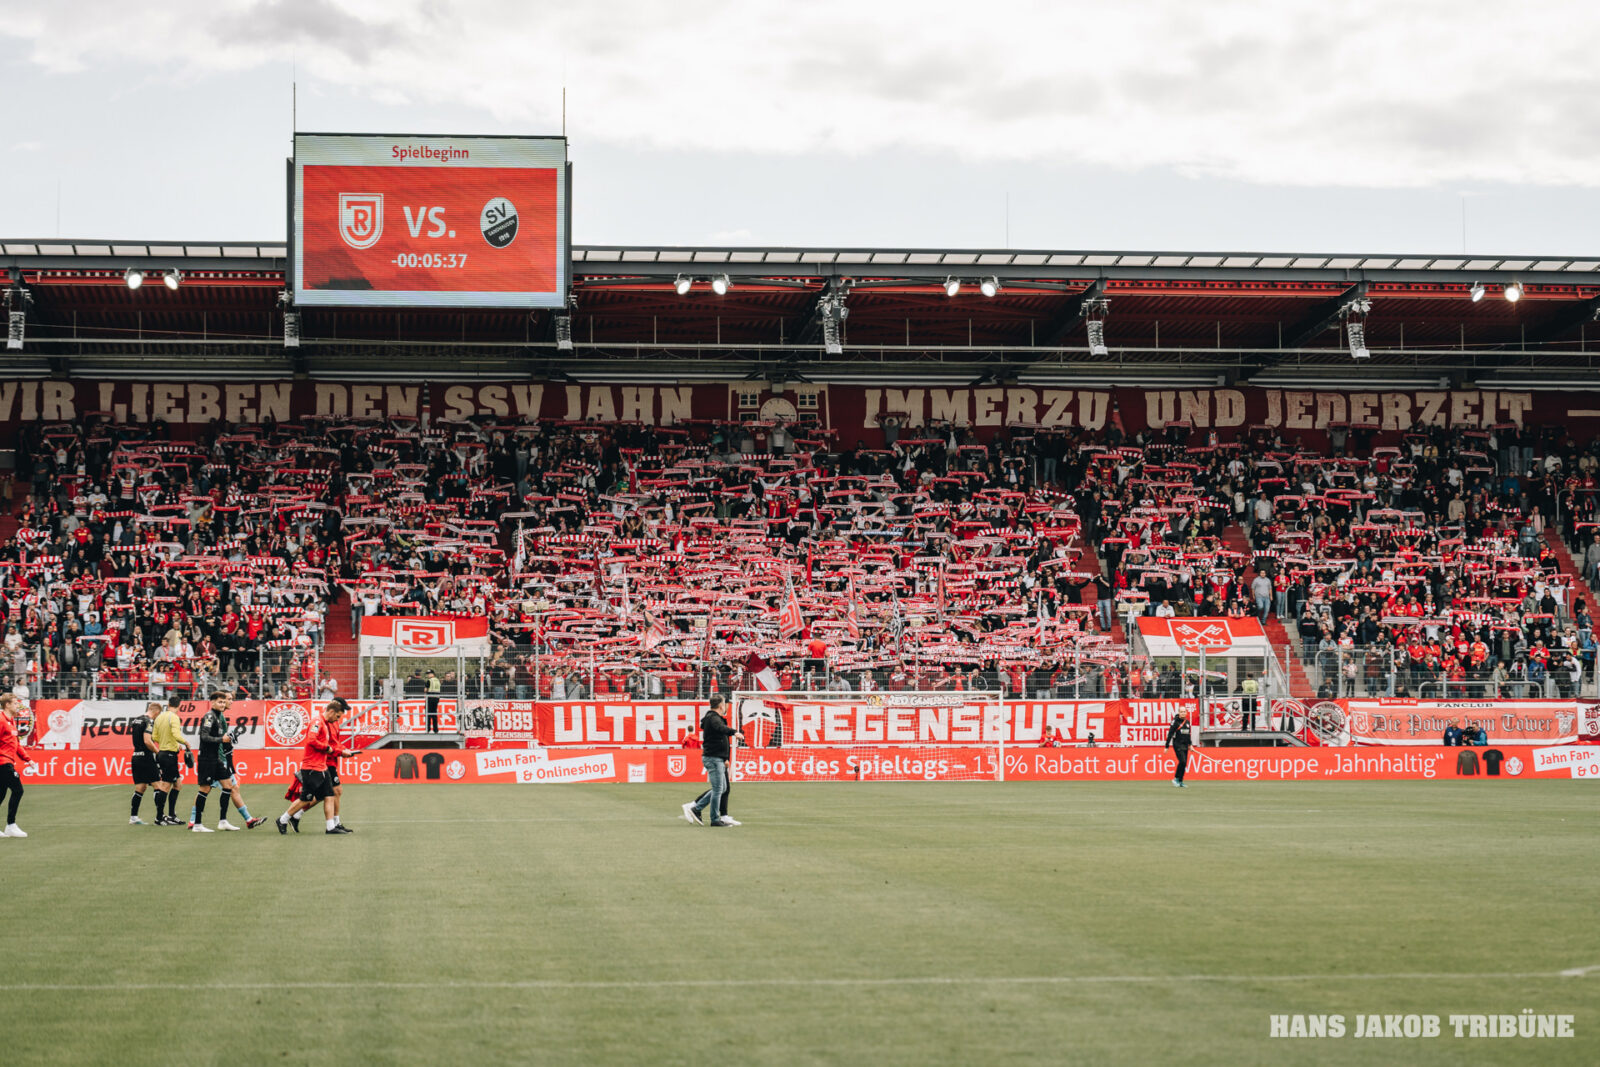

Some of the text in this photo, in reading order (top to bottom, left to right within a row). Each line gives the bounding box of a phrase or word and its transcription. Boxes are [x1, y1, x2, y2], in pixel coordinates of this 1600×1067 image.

[392, 145, 469, 162] Spielbeginn
[403, 206, 456, 238] VS.
[485, 202, 506, 224] SV
[391, 253, 468, 268] -00:05:37
[98, 383, 293, 423] LIEBEN
[315, 383, 419, 420] DEN
[444, 384, 544, 421] SSV
[563, 385, 693, 426] JAHN
[863, 388, 1110, 431] IMMERZU
[1144, 390, 1246, 428] UND
[1264, 391, 1533, 431] JEDERZEIT
[495, 711, 533, 731] 1889
[554, 703, 1105, 742] ULTRA REGENSBURG
[1127, 702, 1180, 724] JAHN
[1371, 714, 1402, 733] Die
[1501, 713, 1553, 733] Tower
[63, 757, 97, 777] die
[483, 754, 542, 769] Jahn Fan-
[801, 755, 840, 775] des
[846, 755, 949, 780] Spieltags
[1005, 755, 1028, 775] %
[1035, 754, 1100, 774] Rabatt
[1110, 754, 1139, 774] auf
[1144, 754, 1175, 774] die
[1184, 754, 1318, 779] Warengruppe
[1540, 751, 1595, 766] Jahn Fan-
[522, 763, 608, 781] & Onlineshop
[1577, 766, 1587, 777] &
